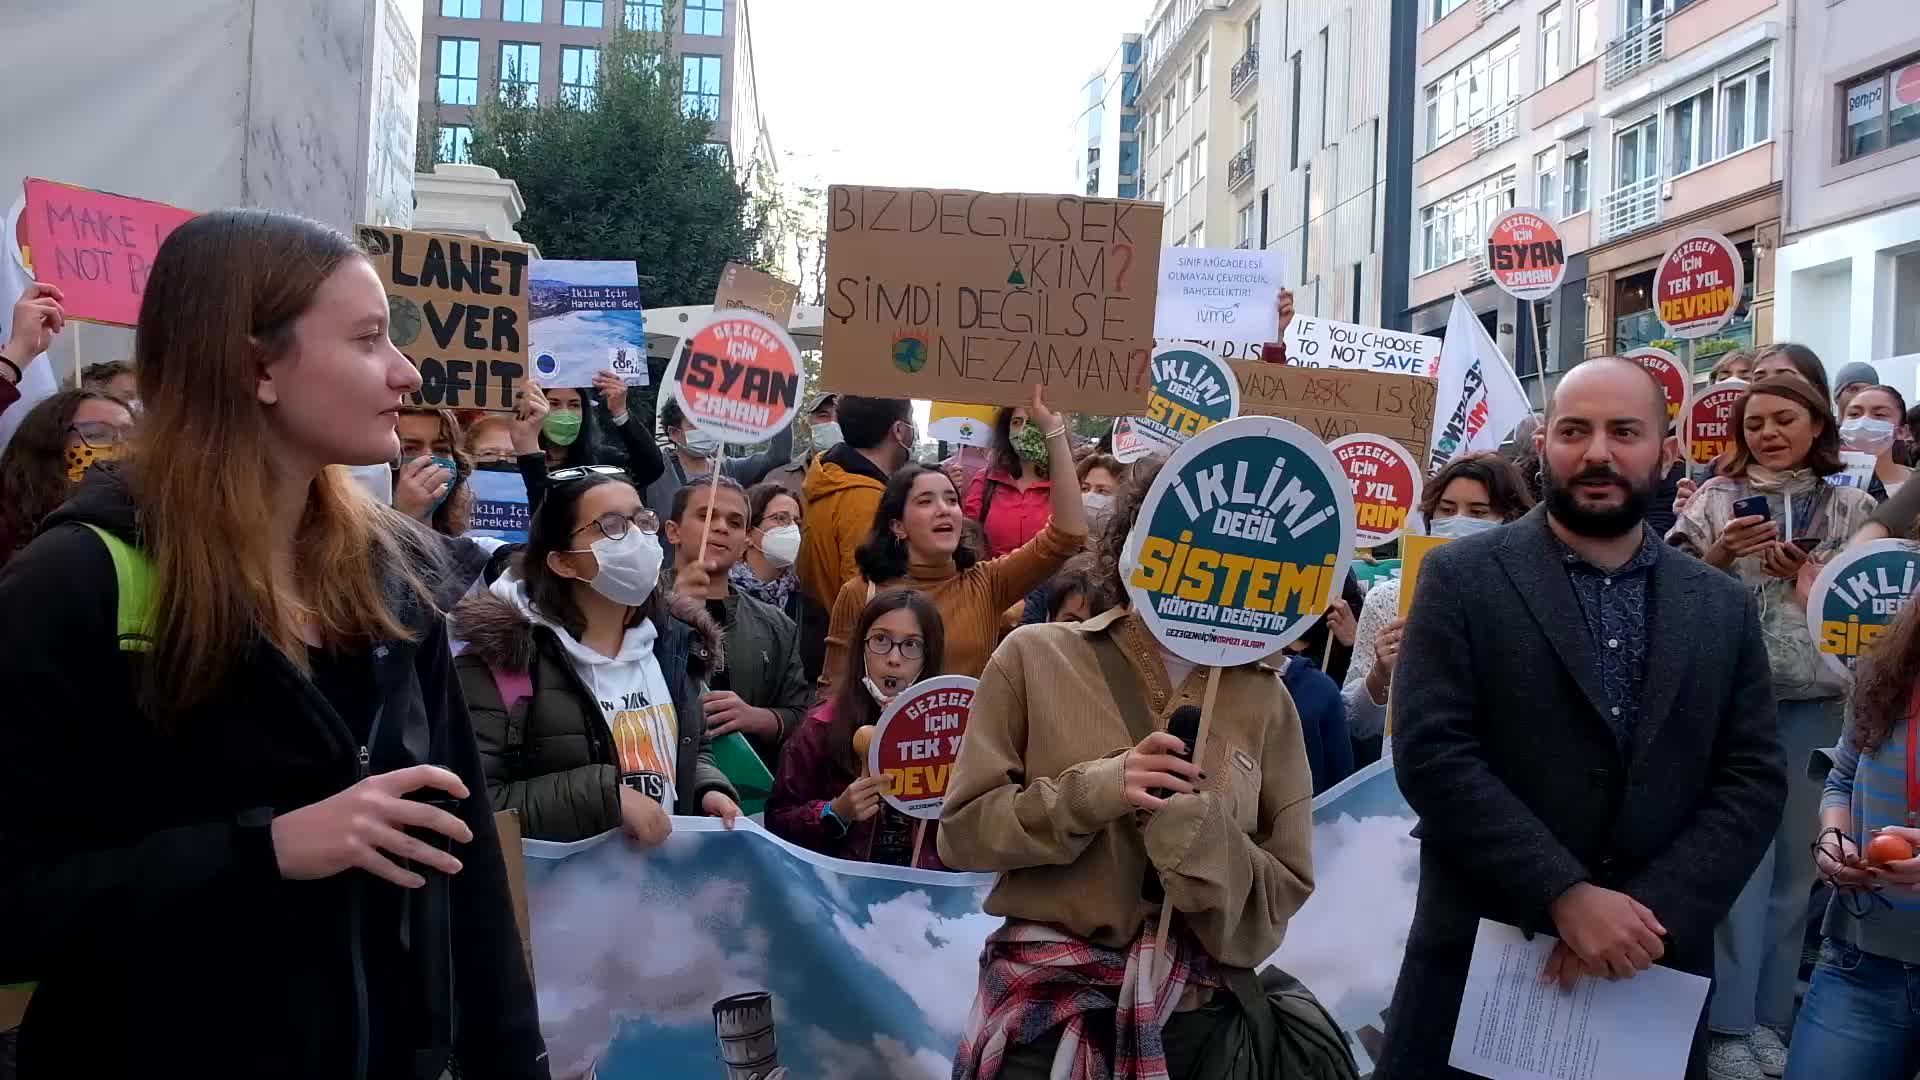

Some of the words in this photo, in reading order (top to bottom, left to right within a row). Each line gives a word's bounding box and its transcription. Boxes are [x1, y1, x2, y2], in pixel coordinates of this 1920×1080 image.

[46, 199, 137, 248] MAKE
[1501, 215, 1544, 233] GEZEGEN
[55, 245, 113, 285] NOT
[1487, 238, 1564, 270] İSYAN
[1671, 240, 1717, 264] GEZEGEN
[1681, 255, 1703, 275] İÇİN
[1030, 243, 1137, 293] KİM?
[1168, 271, 1214, 281] OLMAYAN
[1505, 268, 1553, 286] ZAMANI
[1667, 276, 1691, 295] TEK
[1695, 269, 1724, 289] YOL
[571, 287, 600, 298] İklim
[604, 287, 628, 300] İçin
[571, 299, 617, 308] Harekete
[621, 299, 640, 309] Geç
[828, 275, 941, 325] ŞİMDİ
[1660, 285, 1734, 321] DEVRİM
[1297, 319, 1316, 336] IF
[1328, 324, 1358, 344] YOU
[1361, 332, 1424, 354] CHOOSE
[938, 334, 988, 380] NE
[1298, 338, 1320, 356] TO
[1330, 344, 1367, 364] NOT
[1372, 352, 1425, 374] SAVE
[1641, 358, 1671, 373] EGEN
[402, 356, 524, 408] OFIT
[674, 338, 799, 409] İSYAN
[1152, 359, 1229, 406] İKLİMİ
[1235, 371, 1288, 400] VADA
[1167, 380, 1200, 406] DEĞİL
[694, 391, 770, 428] ZAMANI
[1716, 405, 1732, 421] İÇİ
[1696, 422, 1728, 437] TEK
[1338, 445, 1398, 468] GEZEGEN
[1350, 458, 1378, 478] İÇİN
[1170, 456, 1336, 540] İKLİMİ
[1365, 481, 1398, 502] YOL
[510, 504, 529, 517] İçi
[1212, 507, 1279, 545] DEĞİL
[1130, 529, 1338, 616] SİSTEMİ
[1830, 560, 1916, 610] İKLİ
[1157, 594, 1219, 622] KÖKTEN
[1220, 606, 1288, 632] DEĞİŞTİR
[905, 692, 973, 720] GEZEGE
[925, 711, 959, 736] İÇİN
[897, 737, 940, 761] TEK
[882, 763, 953, 796] DEV
